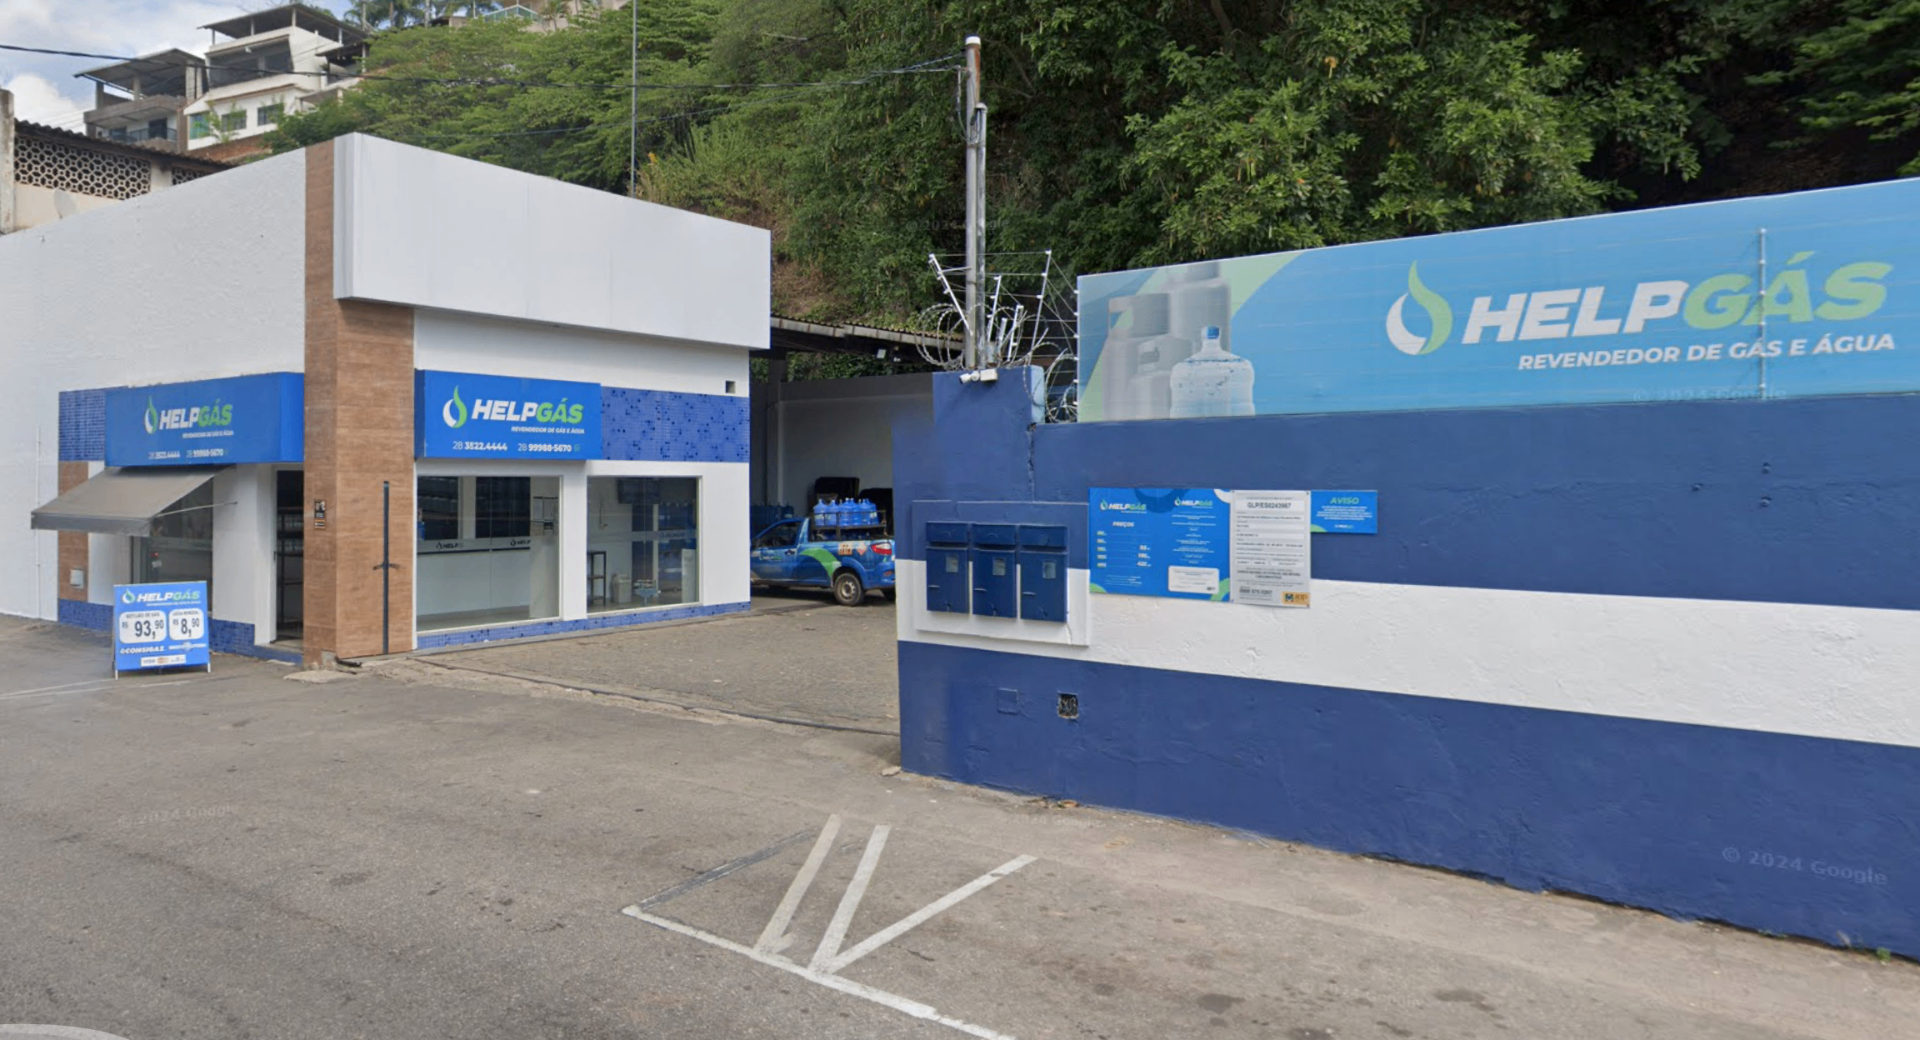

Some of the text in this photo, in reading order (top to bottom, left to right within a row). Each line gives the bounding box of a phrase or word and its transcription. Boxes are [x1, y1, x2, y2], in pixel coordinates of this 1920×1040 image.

[1461, 250, 1894, 345] HELPGÁS
[1518, 333, 1895, 370] REVENDEDOR DE GÁS E ÁGUA
[159, 399, 233, 430] HELPGÁS
[471, 397, 584, 424] HELPGÁS
[452, 441, 508, 451] 28 3522.4444
[517, 443, 528, 452] 28
[1330, 497, 1360, 505] AVISO
[137, 588, 200, 602] HELPGÁS
